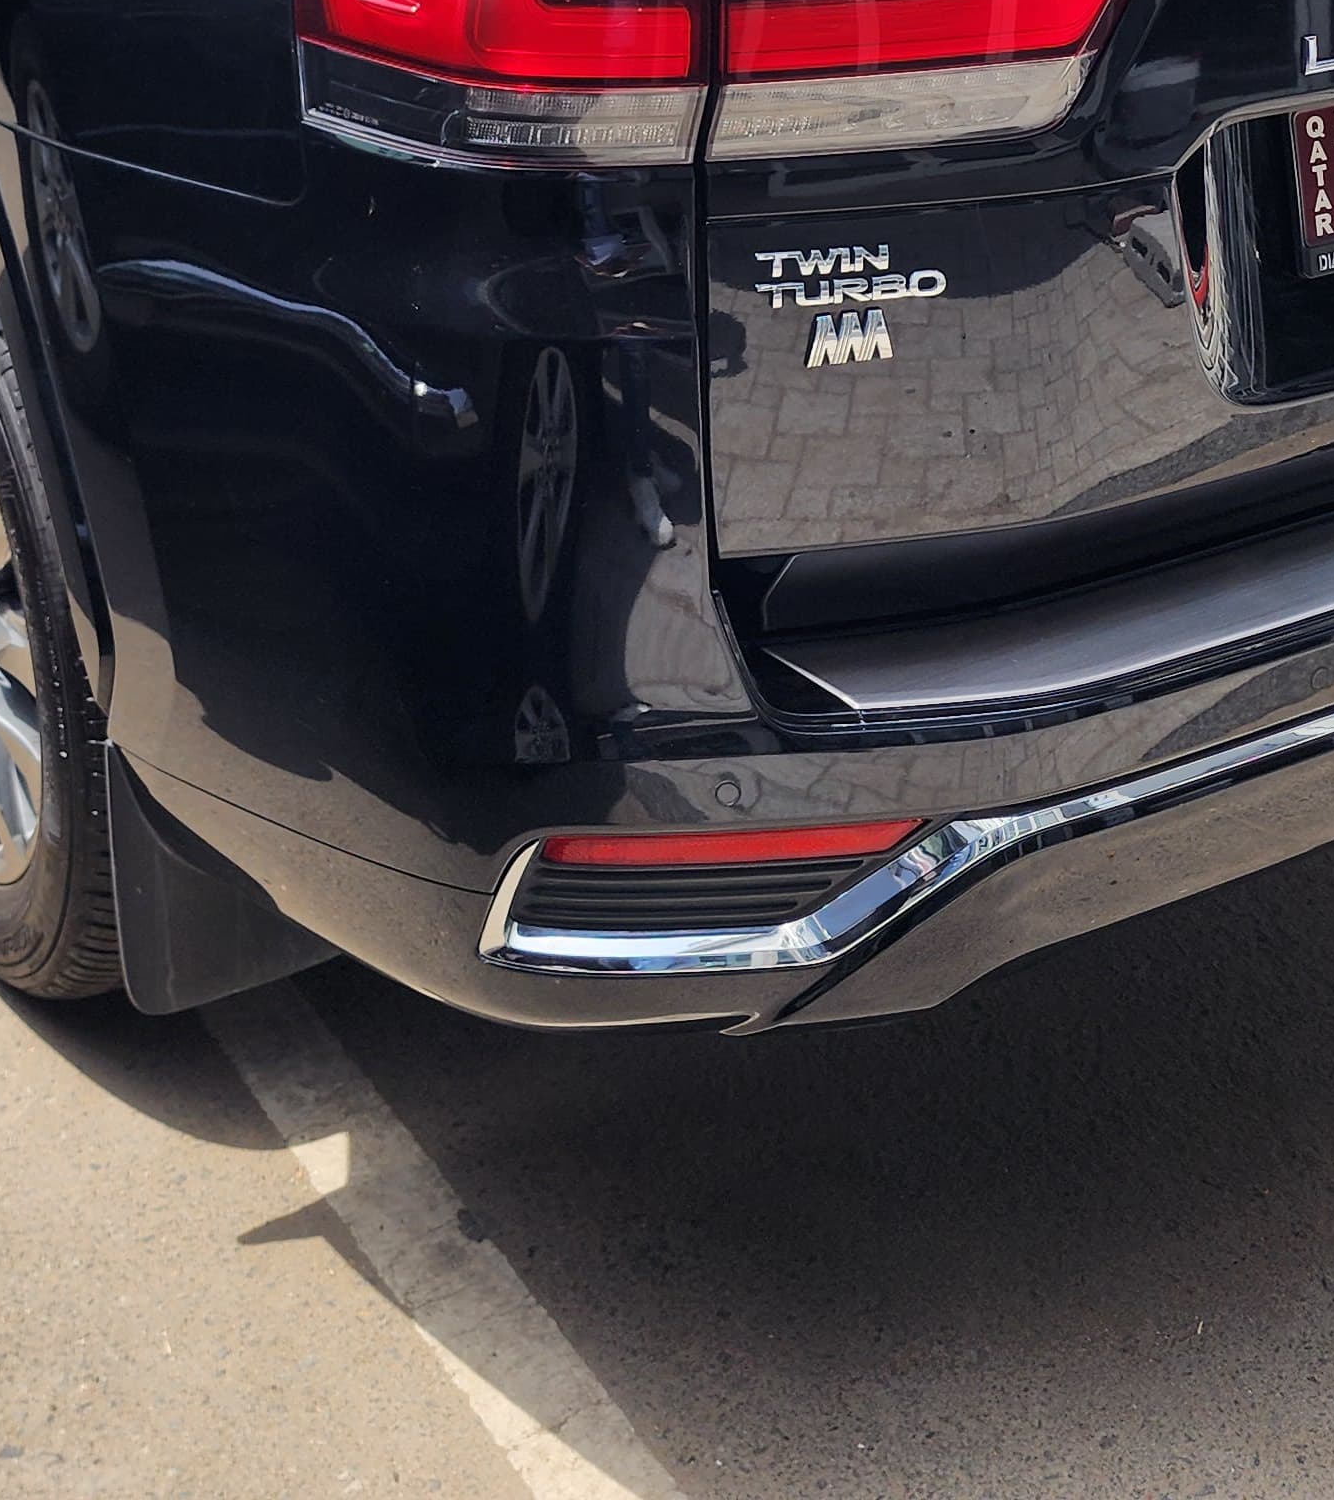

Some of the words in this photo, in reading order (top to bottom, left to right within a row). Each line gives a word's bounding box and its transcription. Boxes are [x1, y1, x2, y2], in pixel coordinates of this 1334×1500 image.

[1305, 115, 1334, 237] QATAR
[755, 244, 889, 278] TWIN
[755, 269, 947, 309] TURBO
